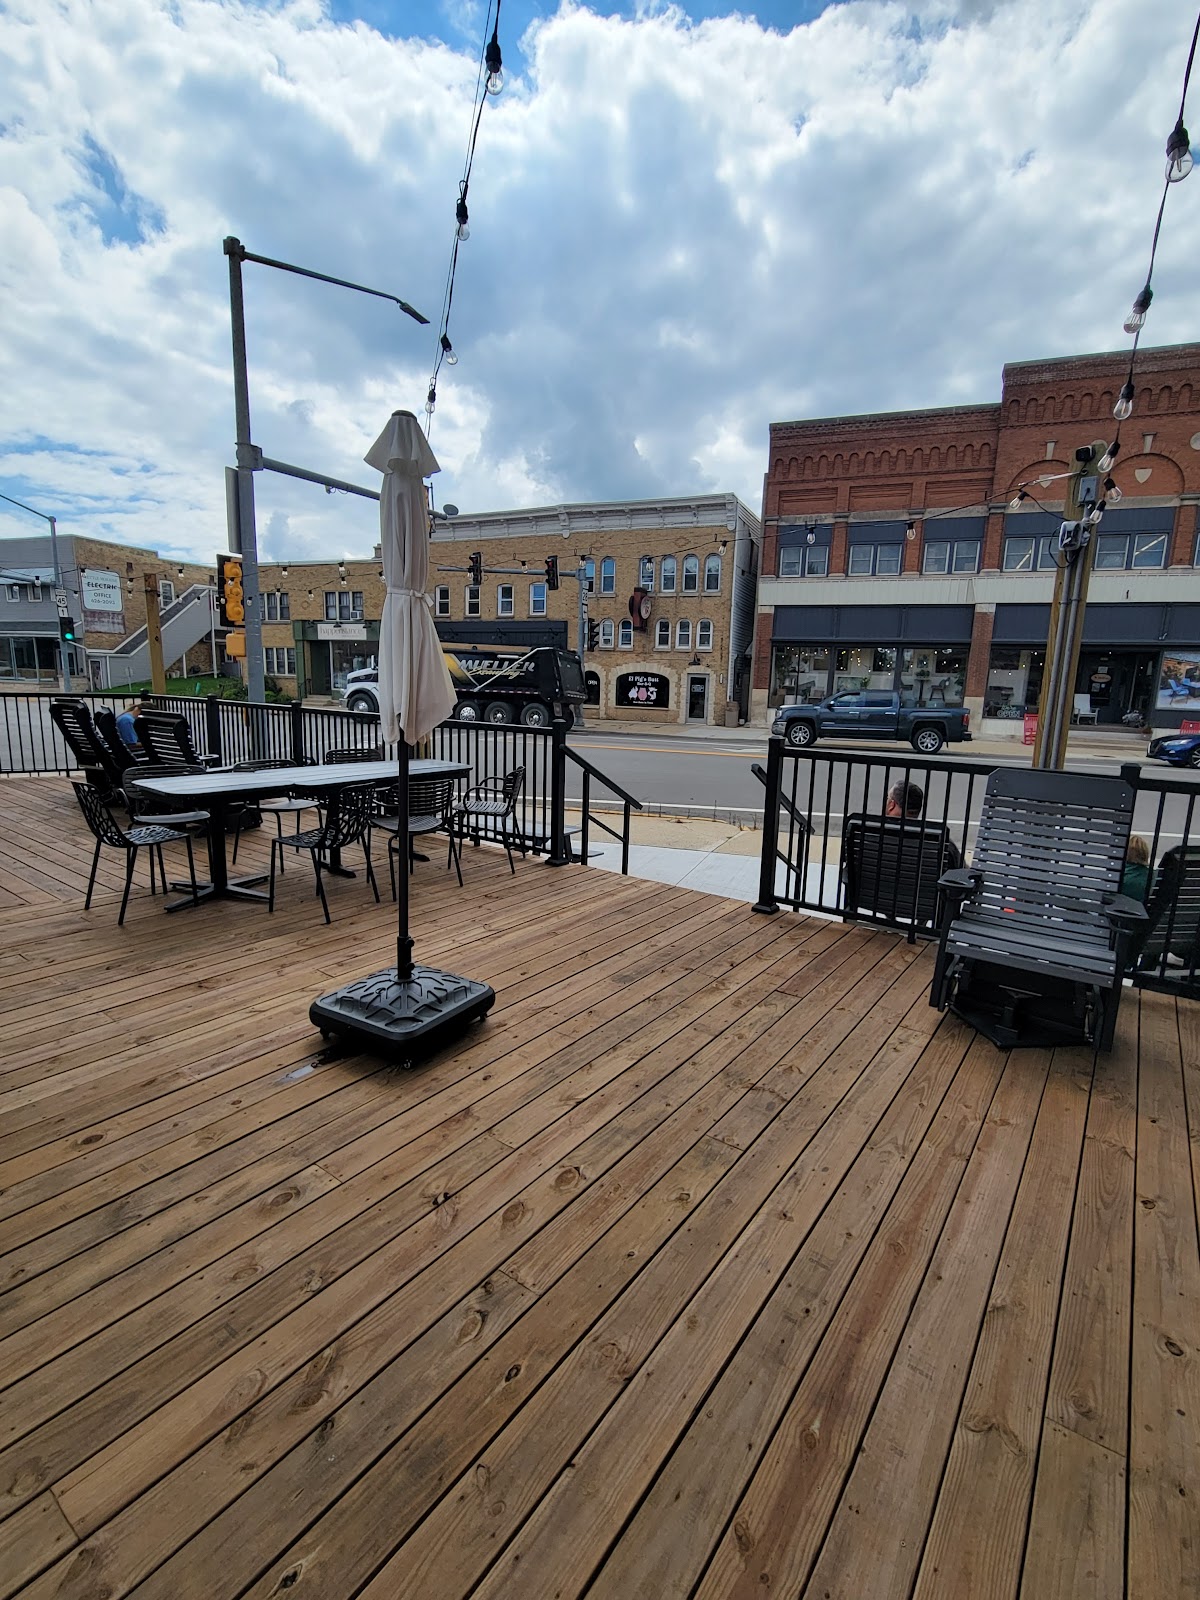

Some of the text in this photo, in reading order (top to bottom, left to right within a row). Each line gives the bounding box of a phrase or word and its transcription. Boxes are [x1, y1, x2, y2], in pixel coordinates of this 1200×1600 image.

[87, 582, 117, 590] ELECTRIC
[57, 597, 66, 605] 45
[459, 660, 536, 672] MUELLER
